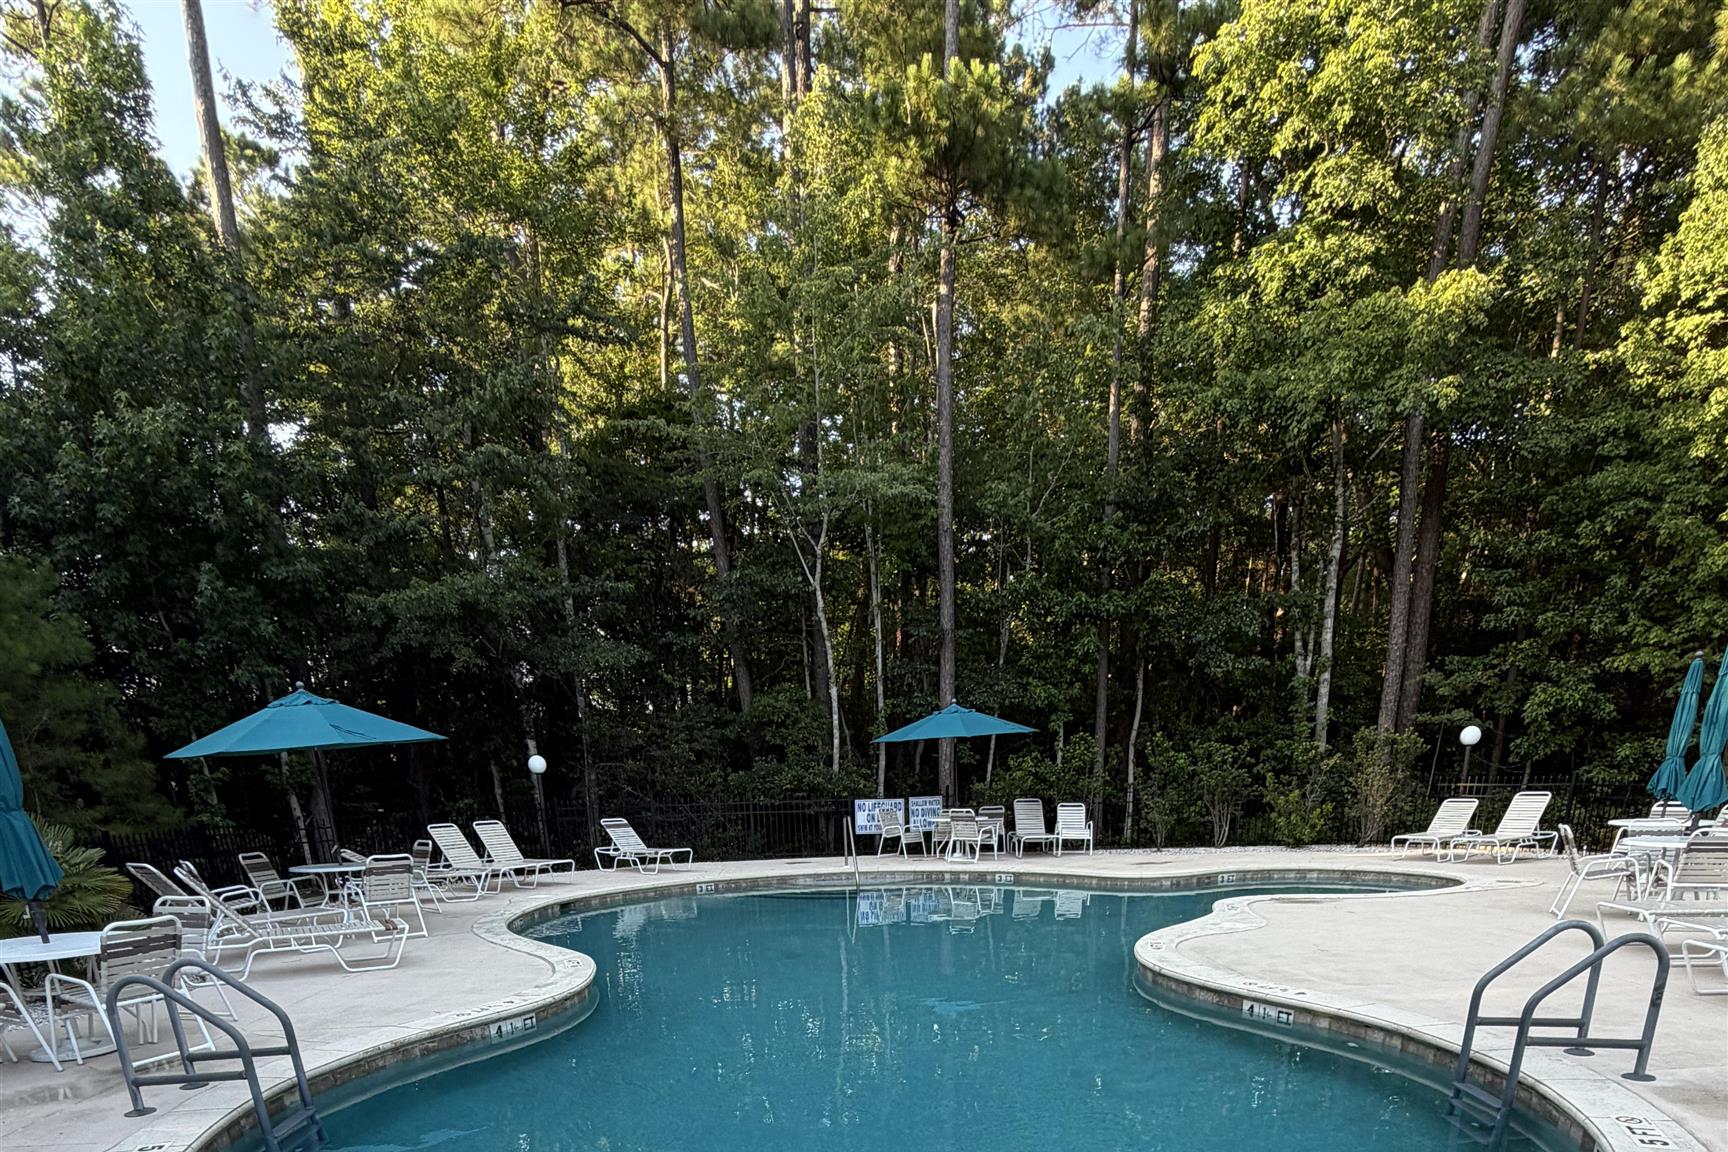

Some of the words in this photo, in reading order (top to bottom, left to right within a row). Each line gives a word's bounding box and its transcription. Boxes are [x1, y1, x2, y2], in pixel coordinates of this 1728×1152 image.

[857, 802, 866, 812] NO
[911, 808, 919, 817] NO
[921, 807, 940, 817] DIVING
[867, 813, 876, 823] ON
[1626, 1126, 1662, 1137] FT
